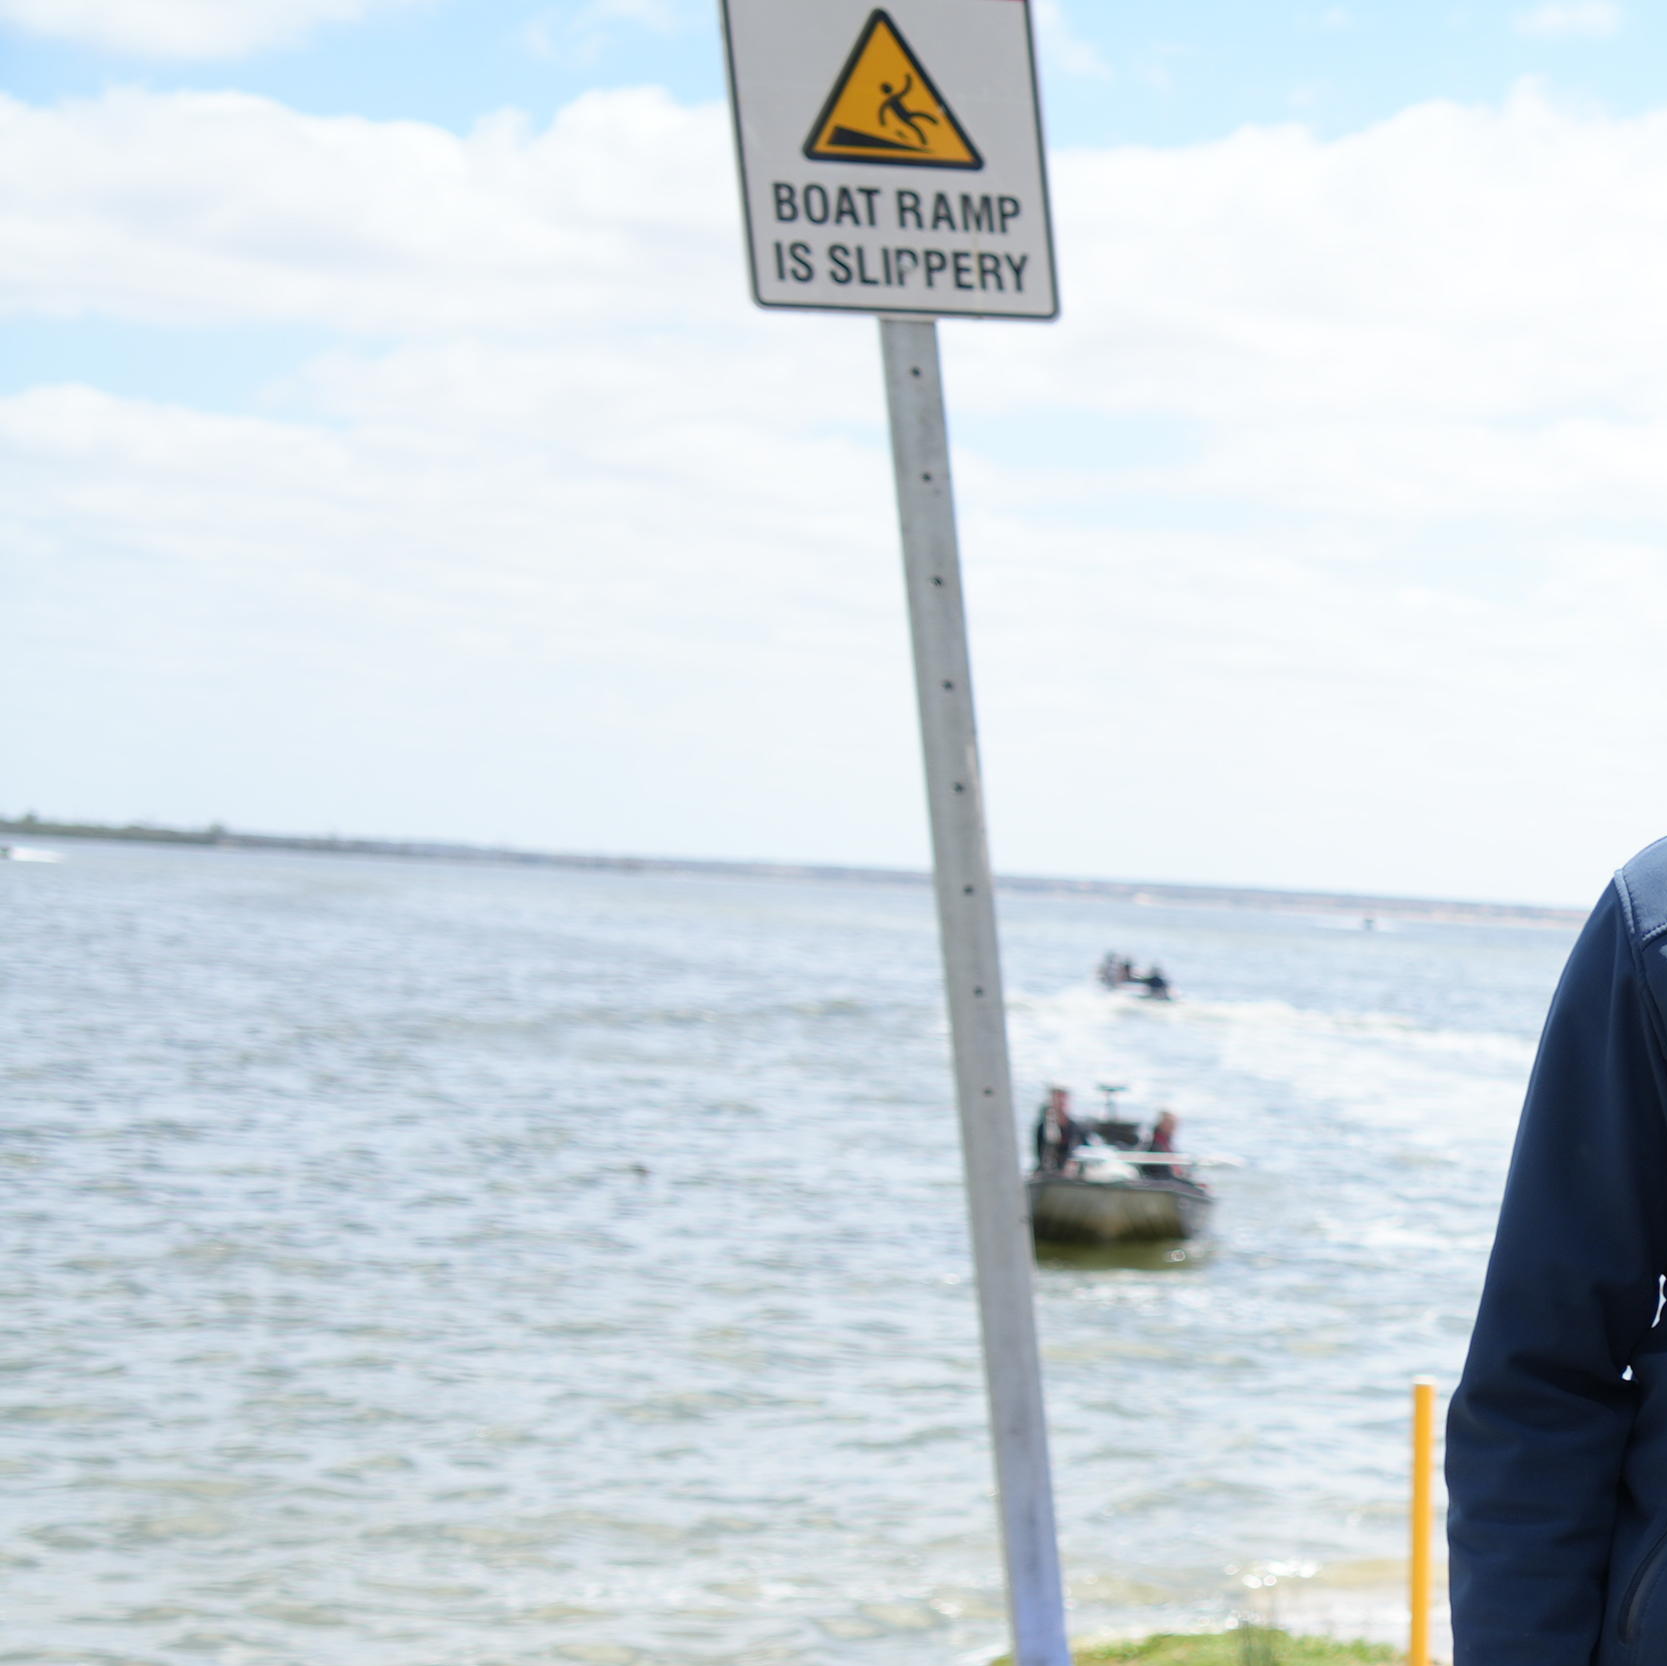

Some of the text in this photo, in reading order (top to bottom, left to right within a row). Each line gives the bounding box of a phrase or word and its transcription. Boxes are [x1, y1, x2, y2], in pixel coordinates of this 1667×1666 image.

[771, 182, 1021, 235] BOAT RAMP
[773, 241, 1029, 293] IS SLIPPERY
